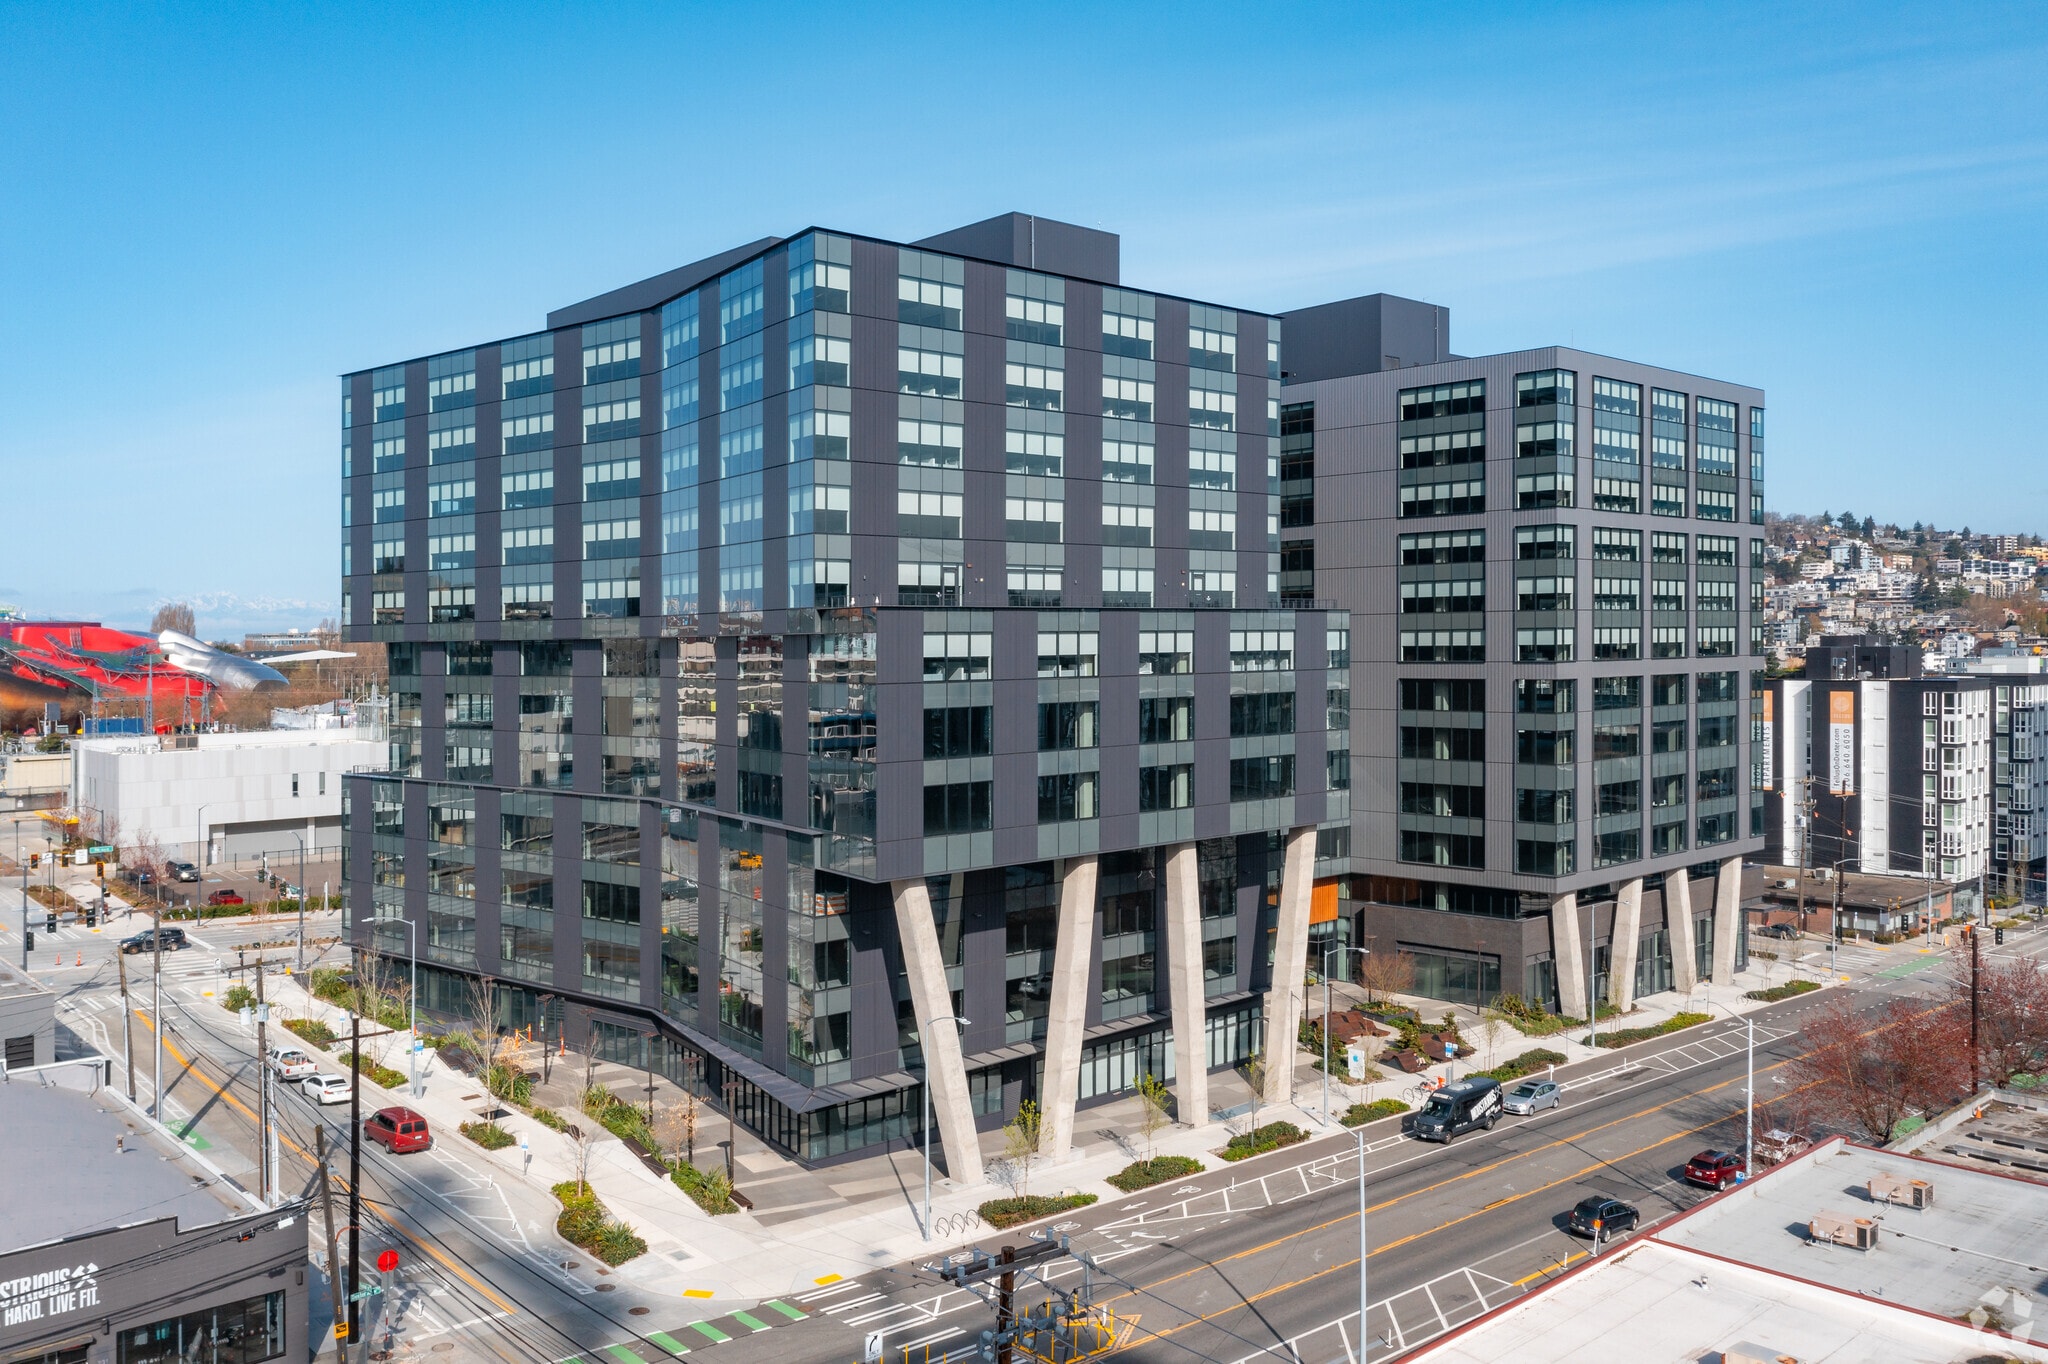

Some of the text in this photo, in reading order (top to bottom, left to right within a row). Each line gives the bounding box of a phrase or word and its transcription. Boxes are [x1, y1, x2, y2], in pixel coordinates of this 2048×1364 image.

[1833, 728, 1841, 787] TellusOnDexter.com
[1843, 728, 1851, 788] 206.640.6050
[4, 1286, 101, 1327] HARD. LIVE FIT.
